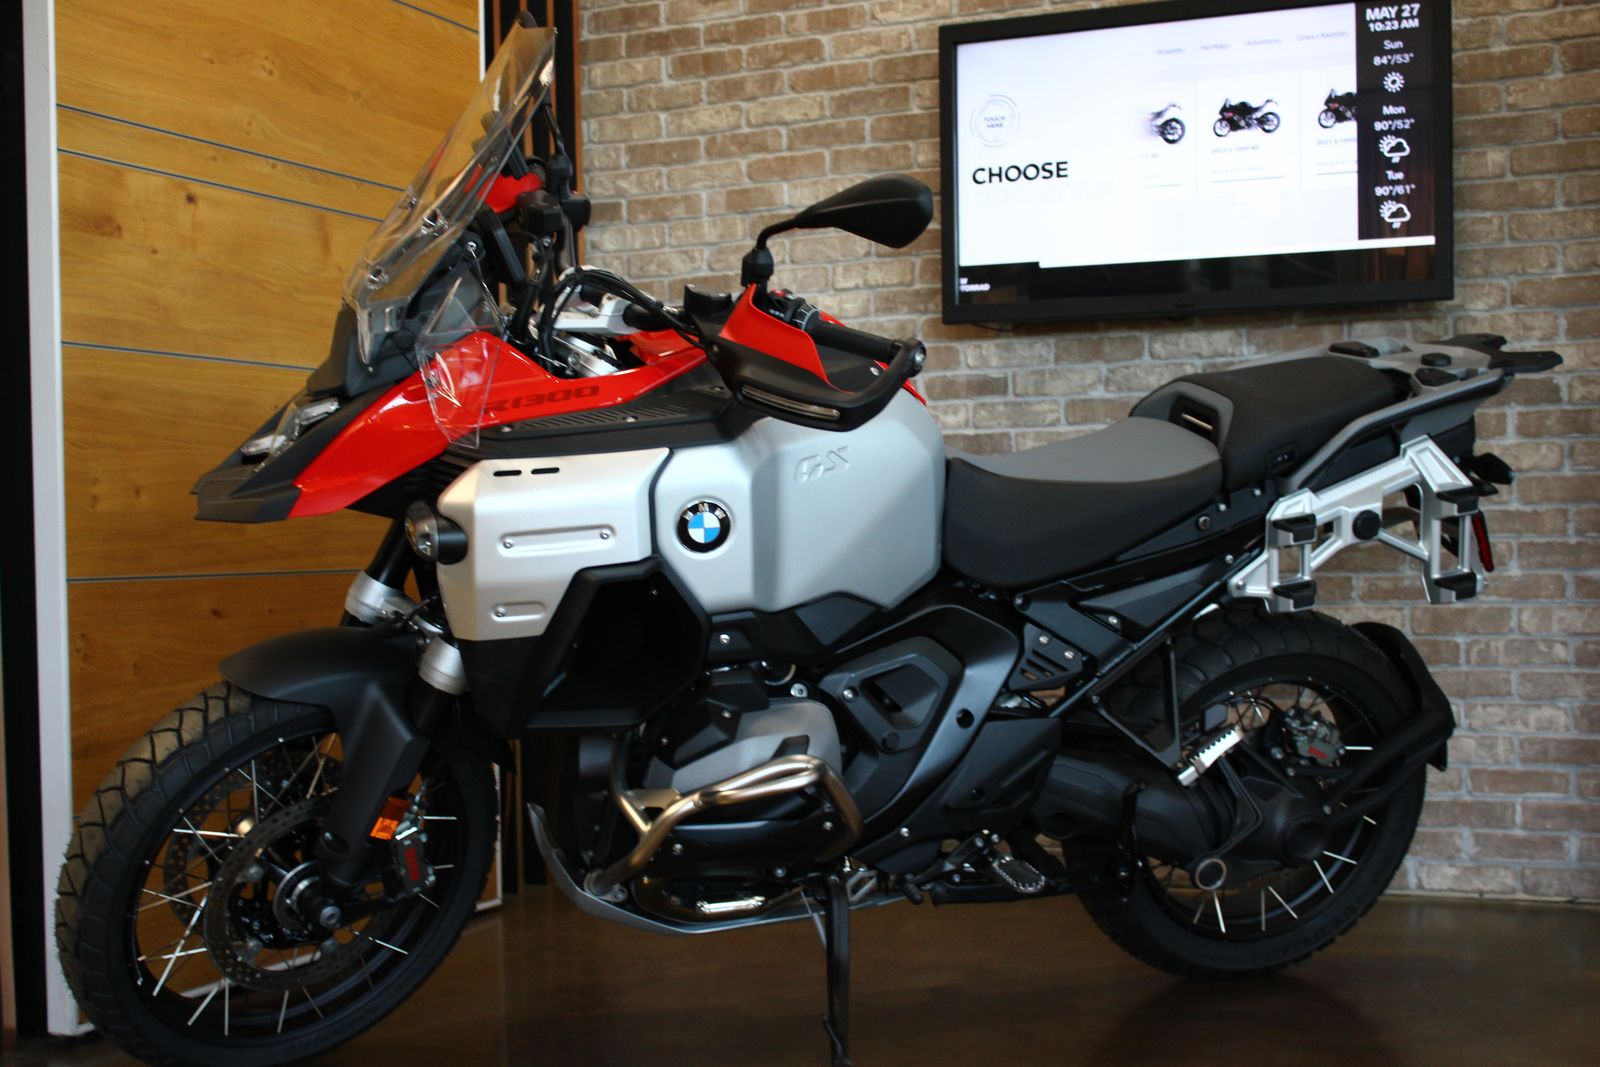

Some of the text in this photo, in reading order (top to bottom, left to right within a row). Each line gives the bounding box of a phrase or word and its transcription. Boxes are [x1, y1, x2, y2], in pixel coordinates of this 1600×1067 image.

[1365, 3, 1420, 21] MAY 27
[1368, 18, 1420, 32] 10:23 AM
[1383, 39, 1404, 50] Sun
[1382, 105, 1406, 115] Mon
[972, 161, 1069, 185] CHOOSE
[1385, 170, 1405, 181] Tue
[681, 501, 727, 521] BMW
